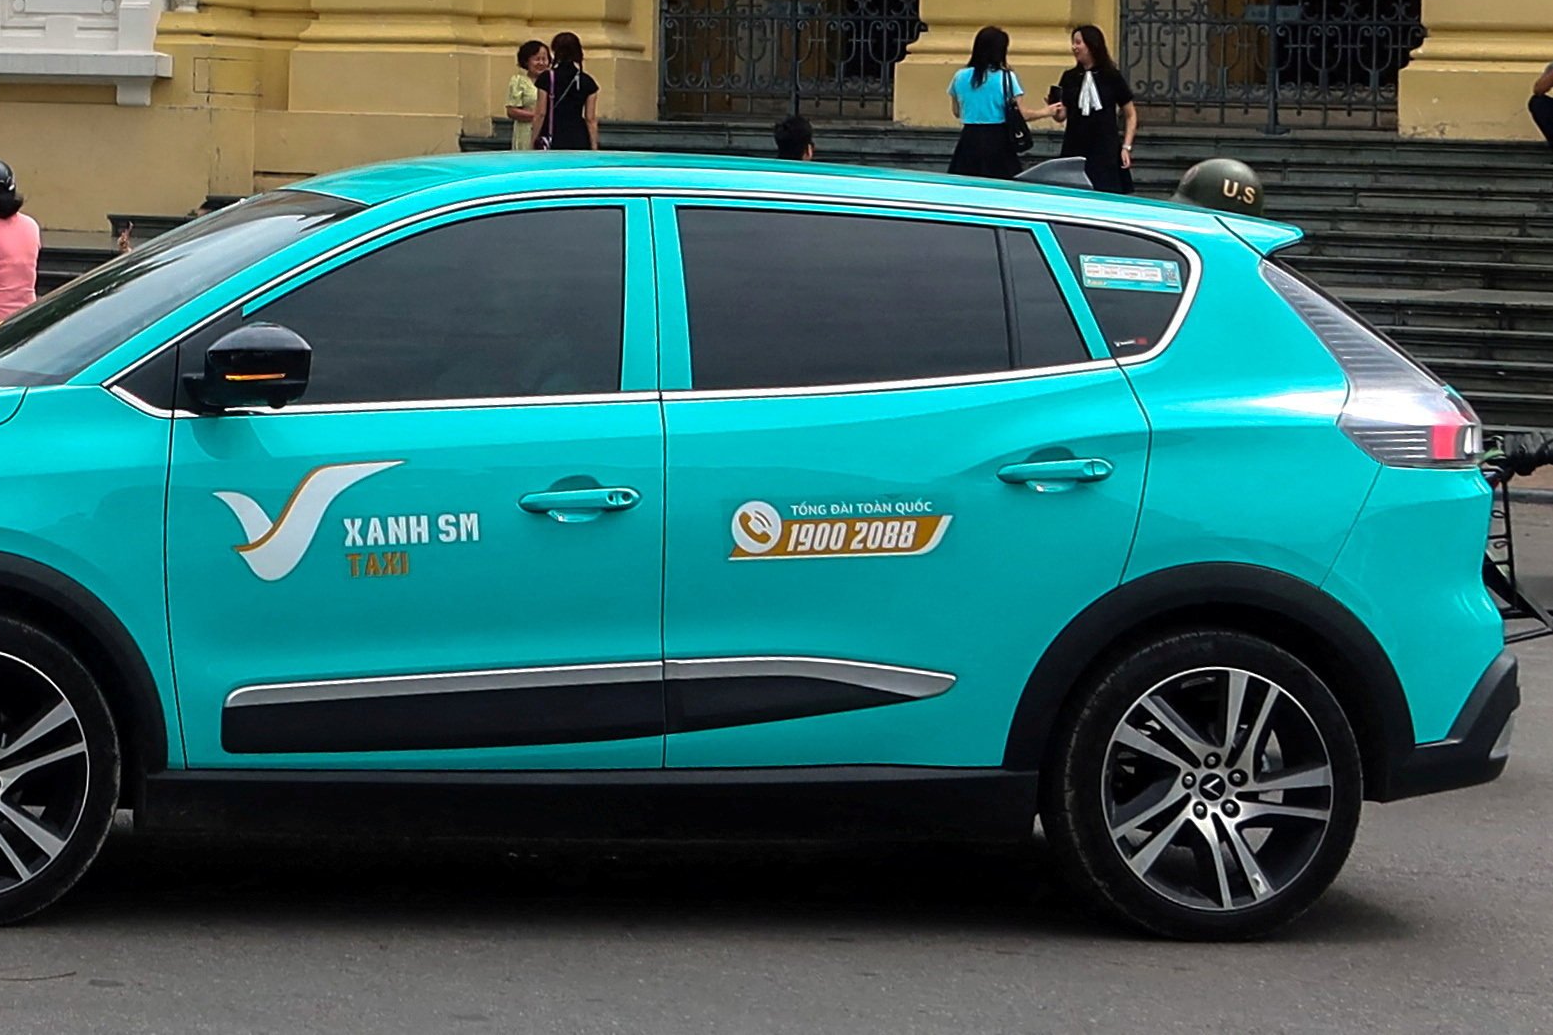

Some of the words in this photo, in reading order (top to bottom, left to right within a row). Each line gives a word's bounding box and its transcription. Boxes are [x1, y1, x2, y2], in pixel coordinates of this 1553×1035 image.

[830, 500, 853, 515] ĐÀI
[856, 499, 892, 515] TOÀN
[895, 497, 932, 515] QUỐC
[343, 515, 429, 547] XANH
[438, 513, 479, 543] SM
[787, 522, 847, 552] 1900
[850, 520, 917, 550] 2088
[346, 552, 409, 578] TAXI
